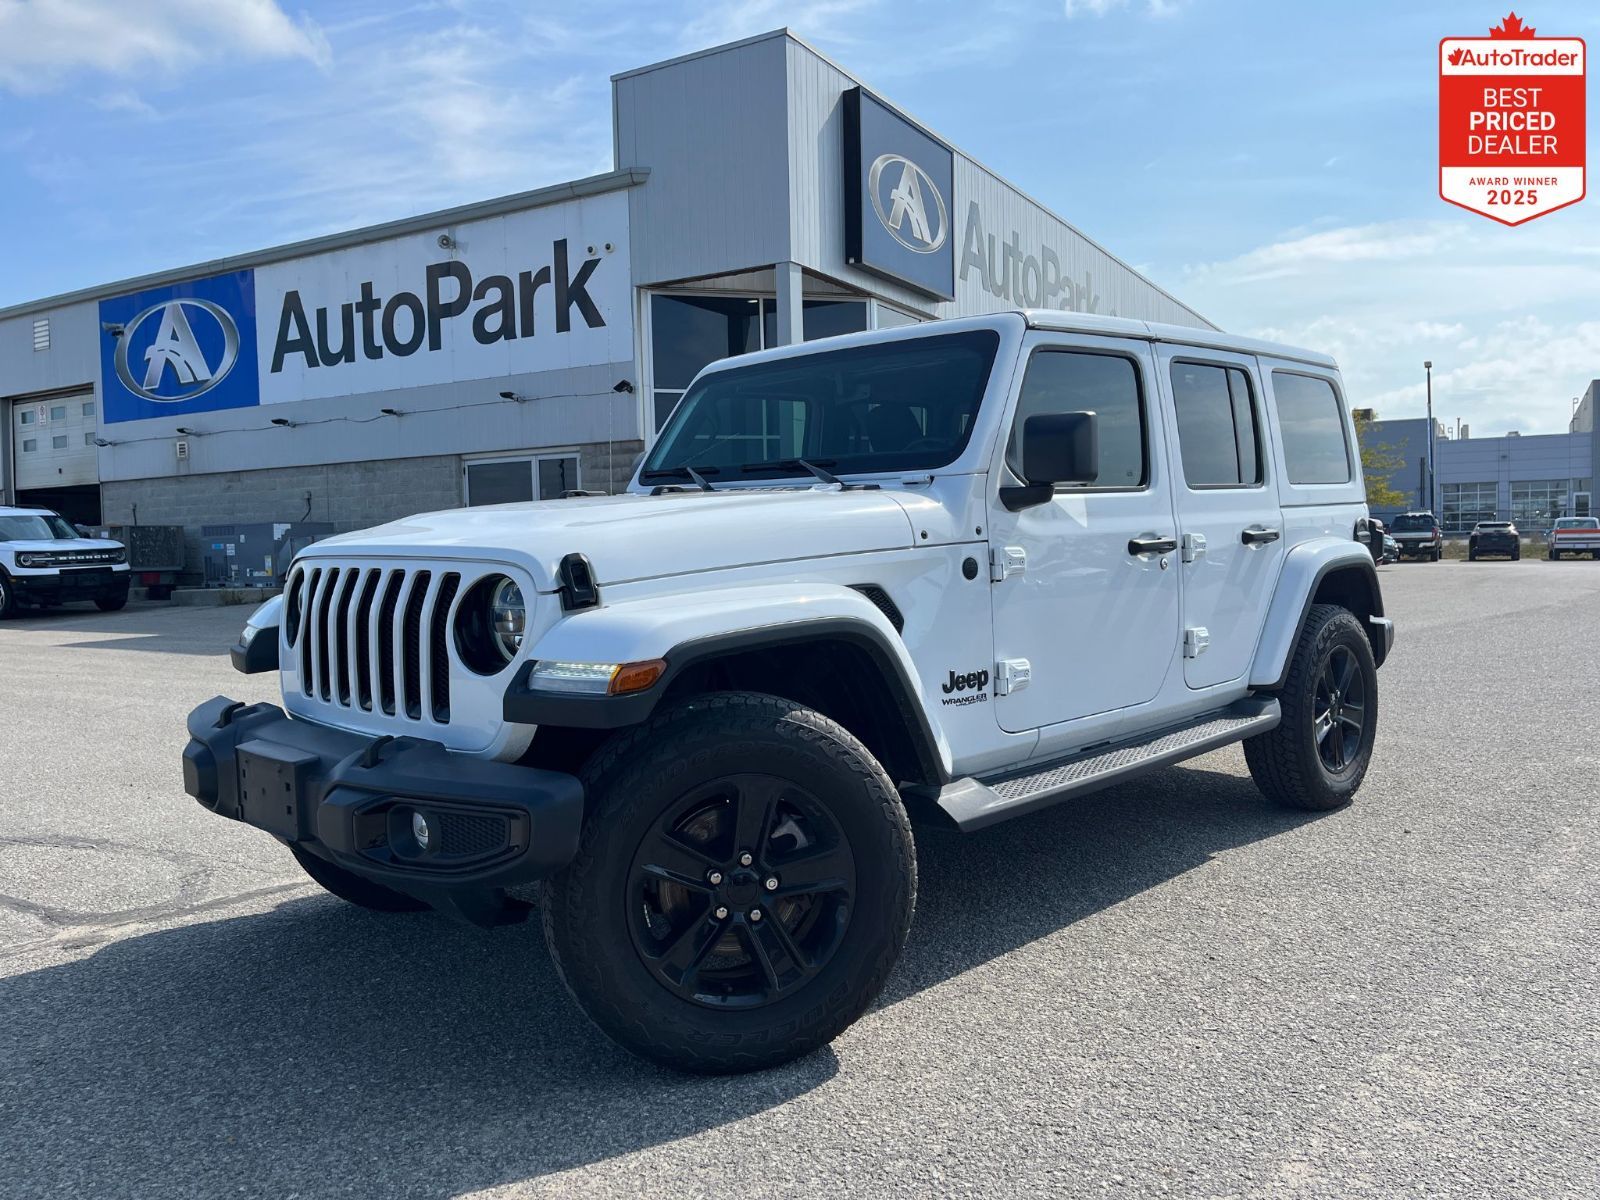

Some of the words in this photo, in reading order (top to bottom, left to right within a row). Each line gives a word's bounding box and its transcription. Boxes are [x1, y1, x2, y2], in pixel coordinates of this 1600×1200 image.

[960, 200, 1100, 314] AutoPark
[271, 238, 607, 373] AutoPark
[942, 669, 989, 694] Jeep
[942, 693, 987, 705] WRANGLER
